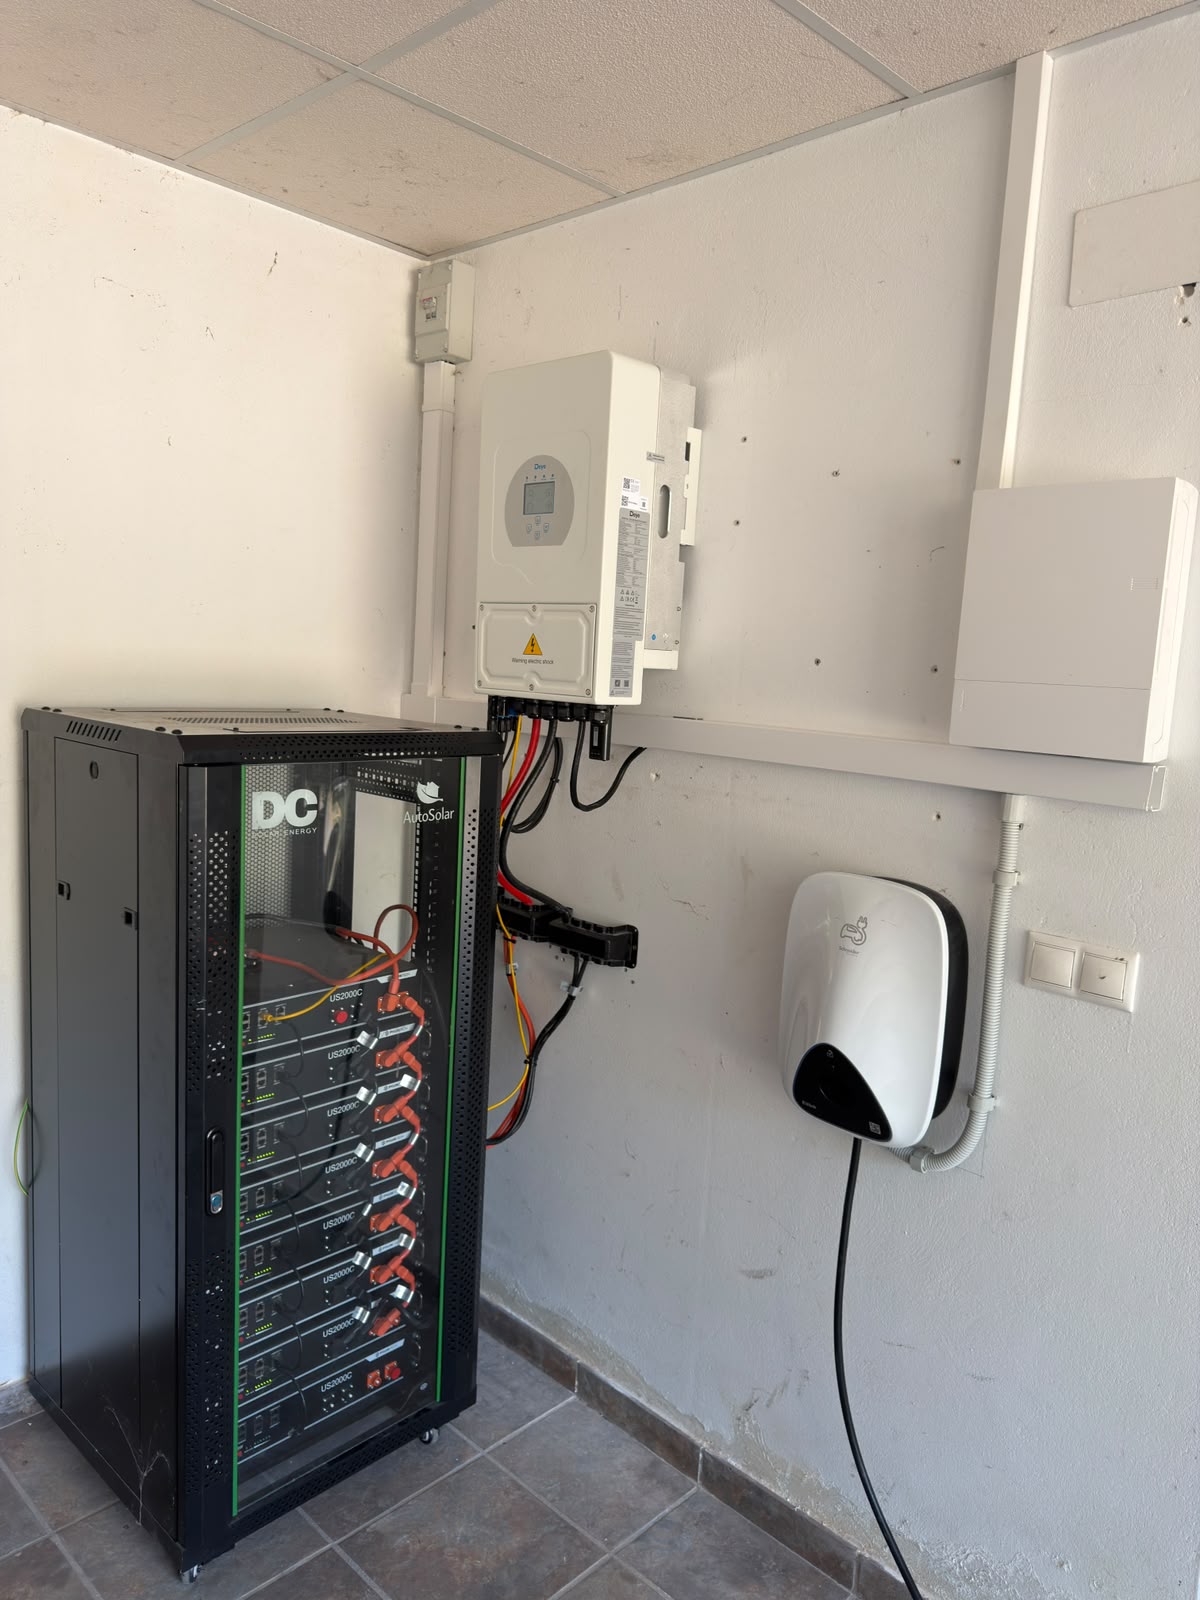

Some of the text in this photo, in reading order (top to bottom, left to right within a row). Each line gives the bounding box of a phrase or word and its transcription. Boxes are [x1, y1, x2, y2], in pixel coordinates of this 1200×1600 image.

[252, 788, 318, 830] DC
[403, 808, 454, 824] AutoSolar
[284, 827, 318, 836] ENERGY
[329, 989, 363, 1003] US2000C
[328, 1045, 361, 1060] US2000C
[327, 1101, 360, 1117] US2000C
[325, 1156, 358, 1174] US2000C
[323, 1211, 355, 1230] US2000C
[323, 1265, 355, 1284] US2000C
[322, 1318, 354, 1338] US2000C
[321, 1371, 353, 1392] US2000C
